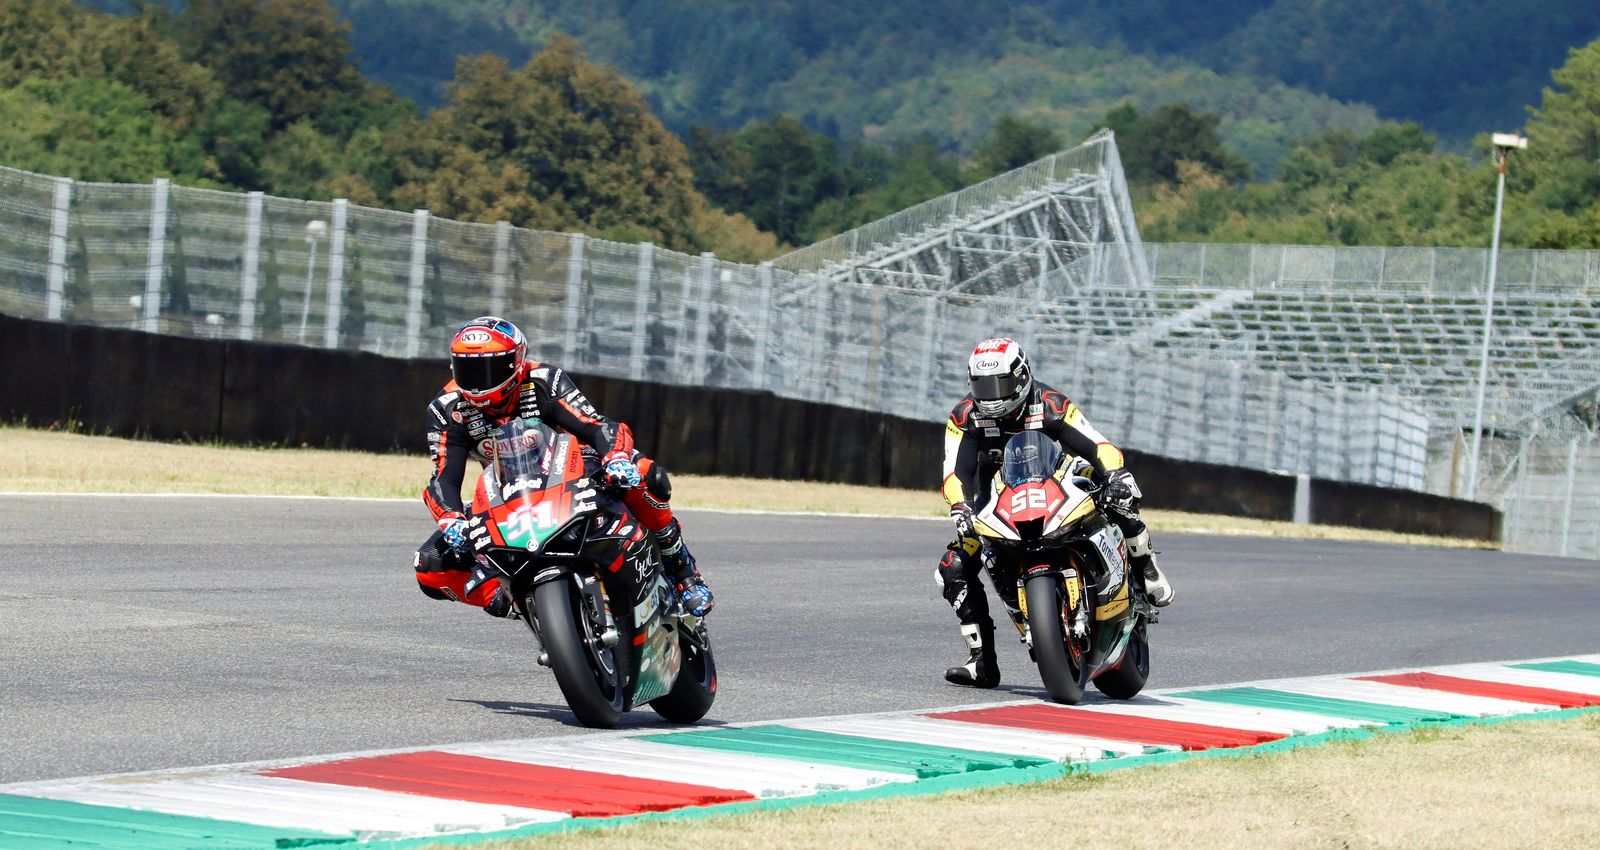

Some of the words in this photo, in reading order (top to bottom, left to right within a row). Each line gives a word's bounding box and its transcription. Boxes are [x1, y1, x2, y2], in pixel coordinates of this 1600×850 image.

[551, 368, 562, 397] VIRCO
[1011, 488, 1047, 514] 52
[507, 500, 553, 541] 51
